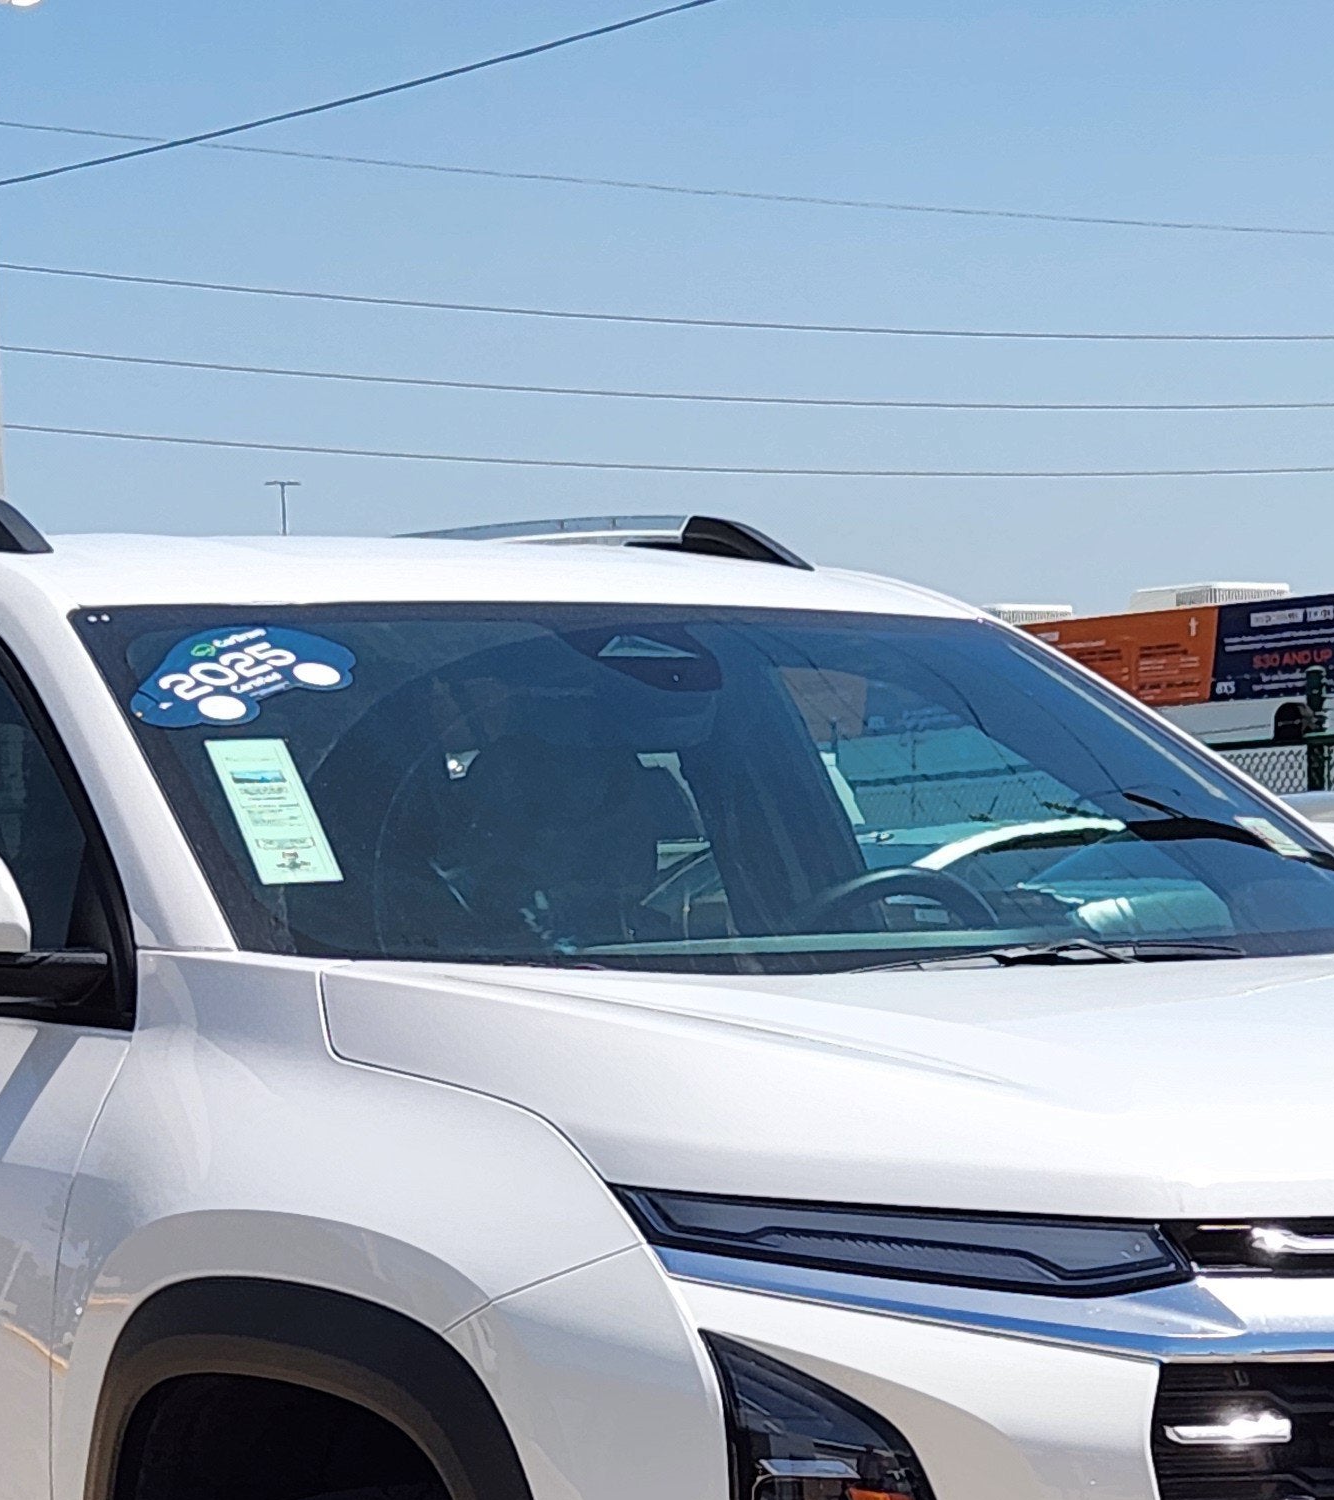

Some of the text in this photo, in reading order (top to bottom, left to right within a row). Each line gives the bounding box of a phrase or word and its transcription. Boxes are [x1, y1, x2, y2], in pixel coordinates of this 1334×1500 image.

[159, 641, 297, 701] 2025
[1282, 650, 1312, 666] AND
[1313, 648, 1333, 663] UP
